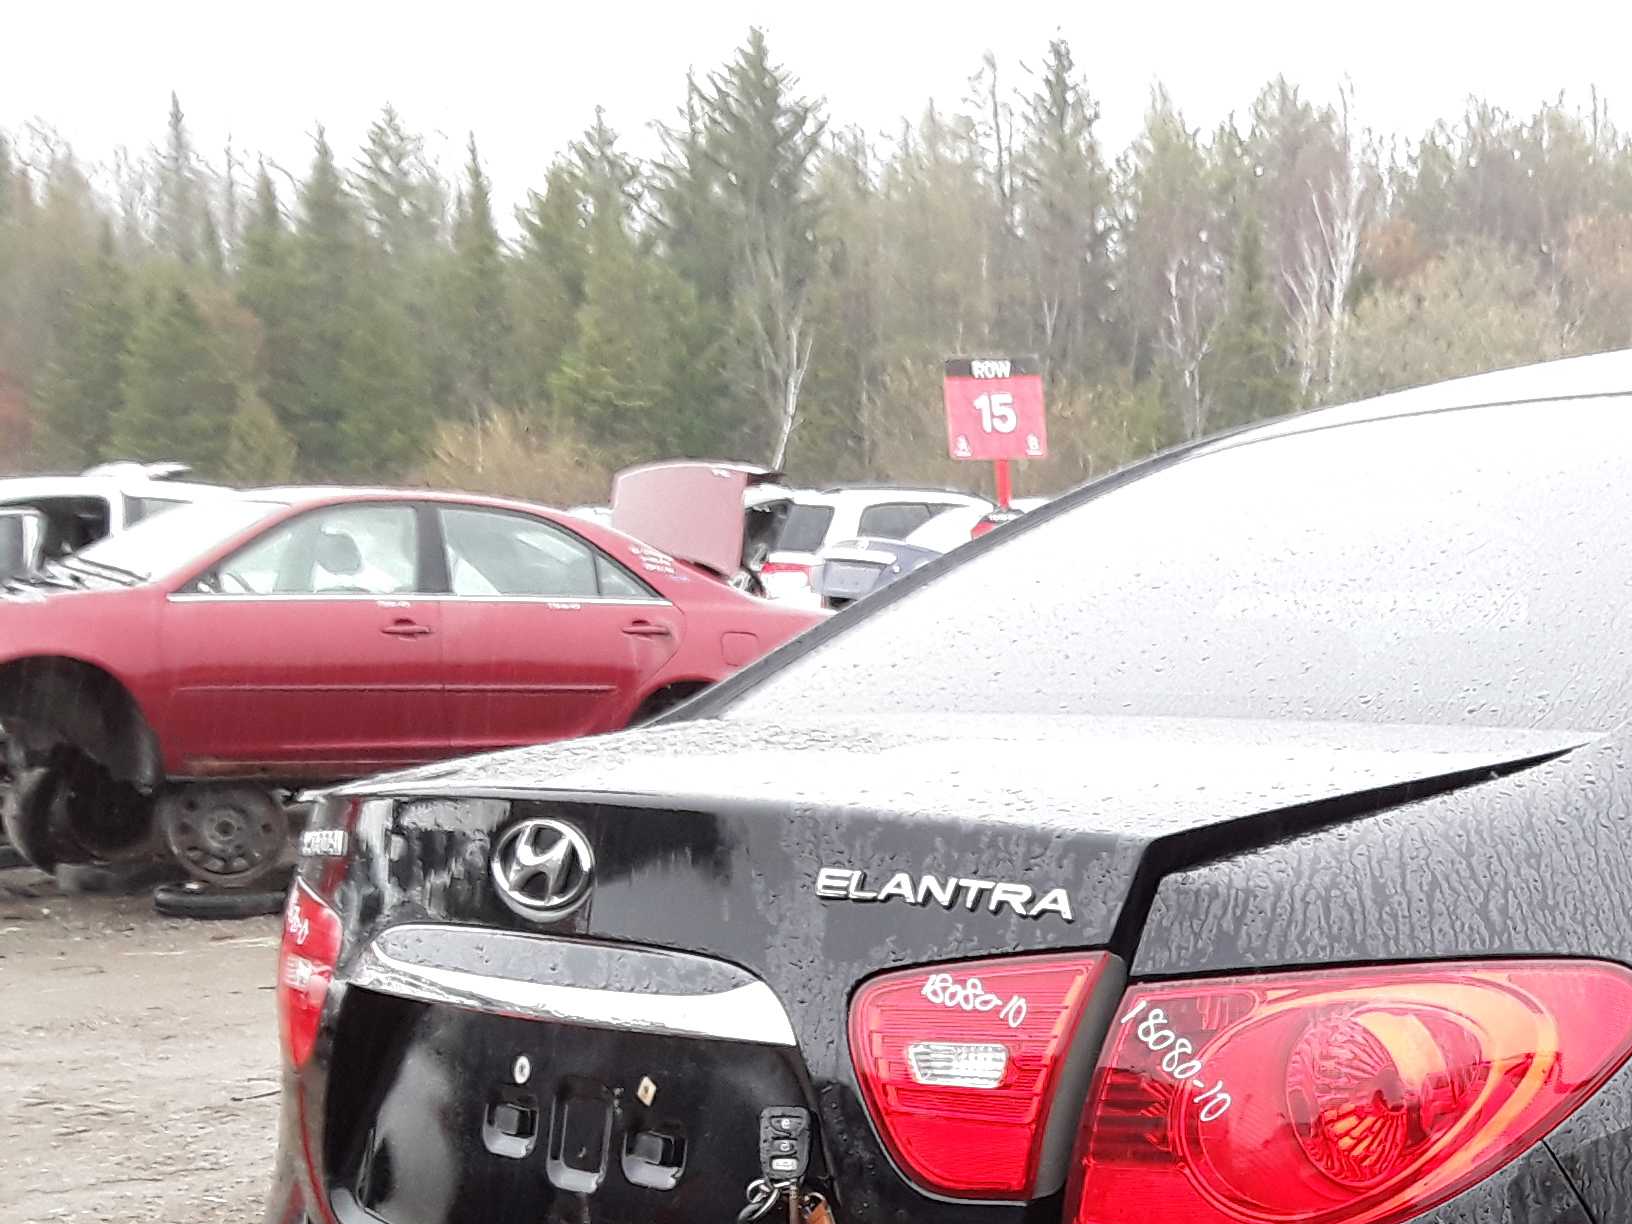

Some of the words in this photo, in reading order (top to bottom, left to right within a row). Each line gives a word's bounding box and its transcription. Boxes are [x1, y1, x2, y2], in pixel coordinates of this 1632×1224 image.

[971, 360, 1011, 378] ROW
[973, 392, 1017, 433] 15
[815, 867, 1074, 921] ELANTRA
[1121, 1000, 1232, 1121] 18080-10
